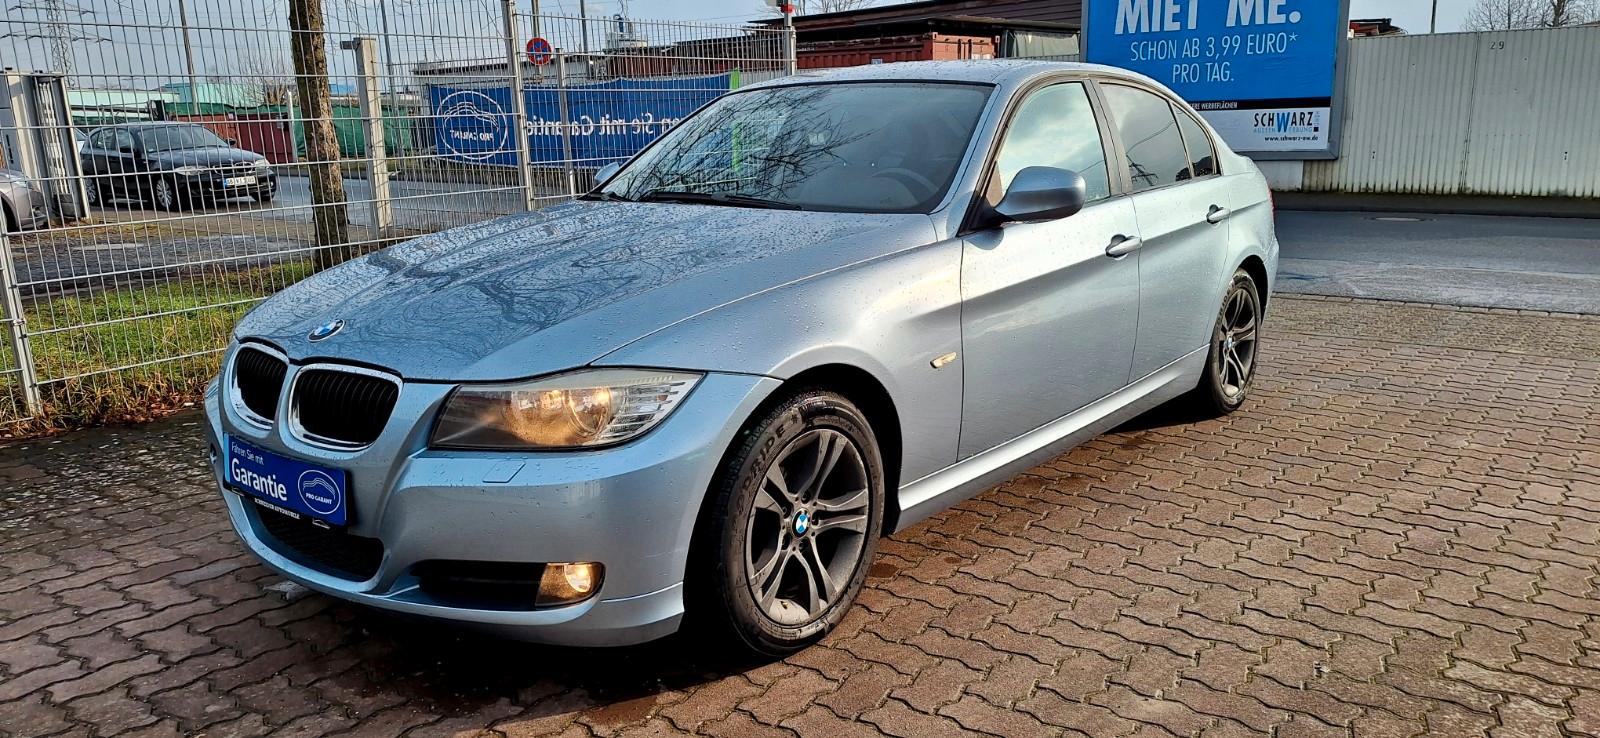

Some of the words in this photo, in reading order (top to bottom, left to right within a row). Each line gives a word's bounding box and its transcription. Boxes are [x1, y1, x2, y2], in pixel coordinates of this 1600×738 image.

[1130, 40, 1177, 61] SCHON
[1182, 37, 1200, 59] AB
[1206, 34, 1241, 60] 3,99
[1172, 62, 1200, 84] PRO
[1206, 61, 1235, 82] TAG.
[1254, 111, 1313, 133] SCHWARZ
[231, 457, 288, 501] Garantie
[305, 492, 315, 500] PRO
